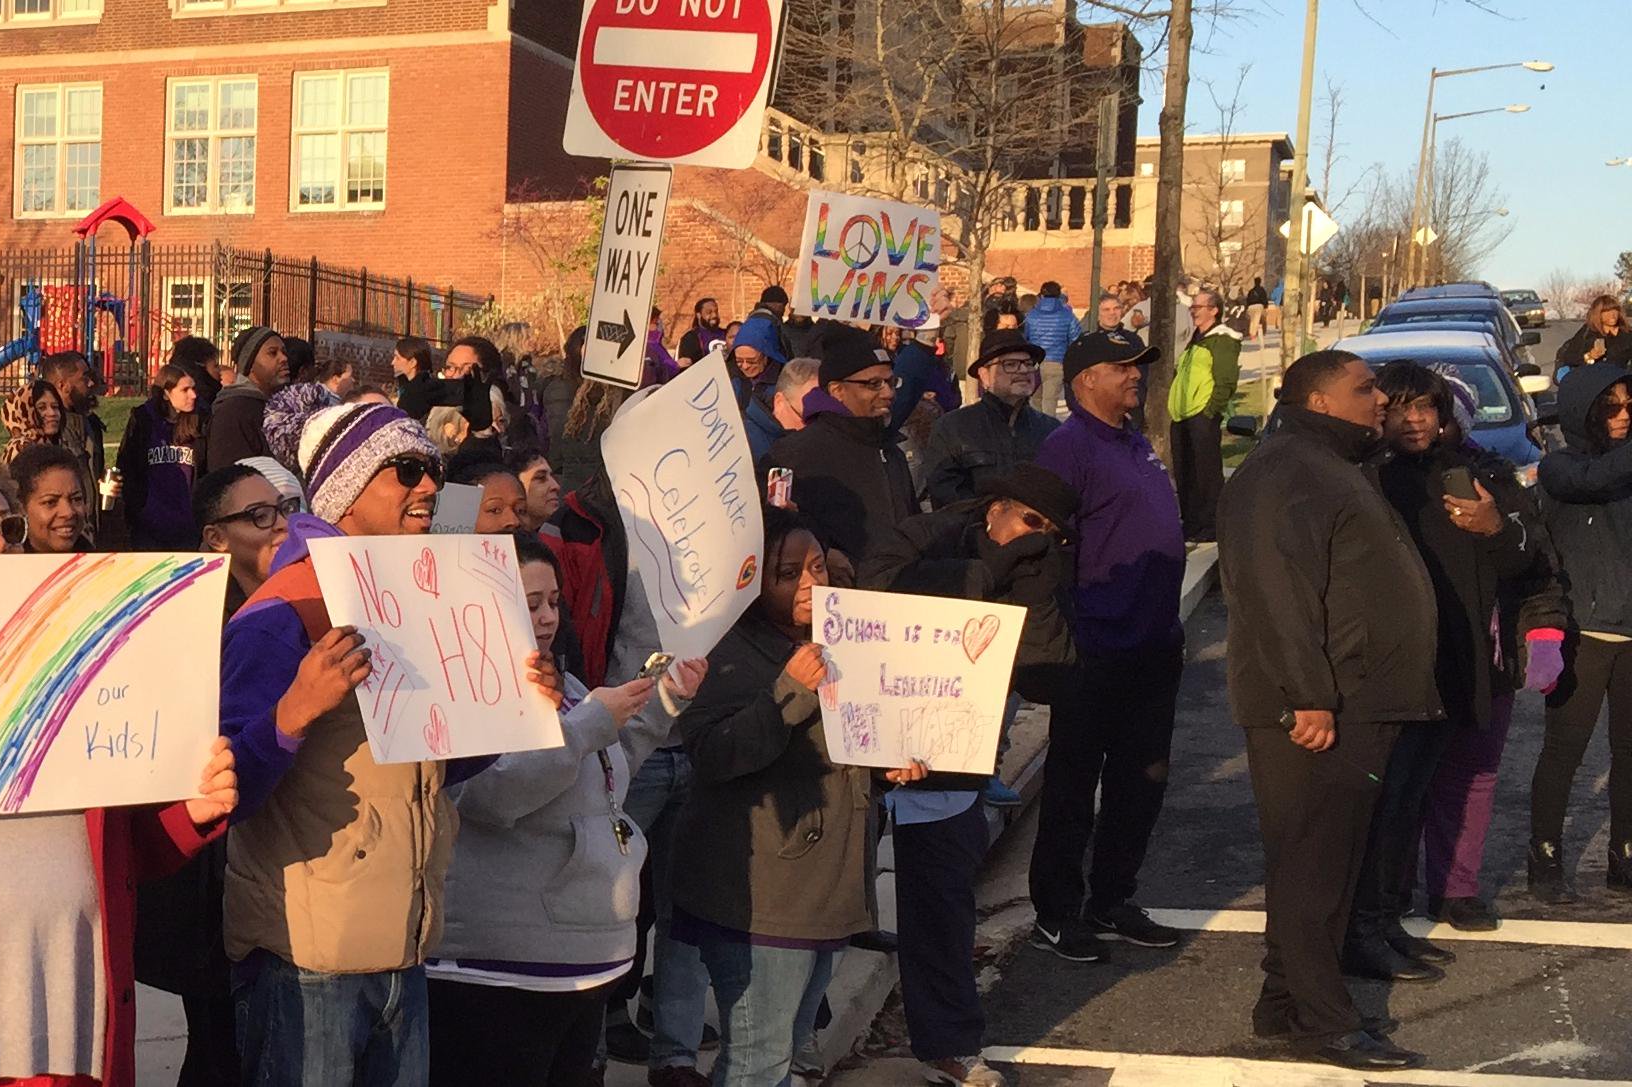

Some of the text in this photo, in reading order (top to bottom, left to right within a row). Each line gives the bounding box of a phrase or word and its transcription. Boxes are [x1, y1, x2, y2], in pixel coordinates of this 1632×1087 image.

[680, 0, 741, 19] NOT
[613, 79, 719, 118] ENTER
[615, 190, 658, 238] ONE
[814, 202, 939, 273] LOVE
[604, 248, 650, 297] WAY
[97, 684, 130, 706] our
